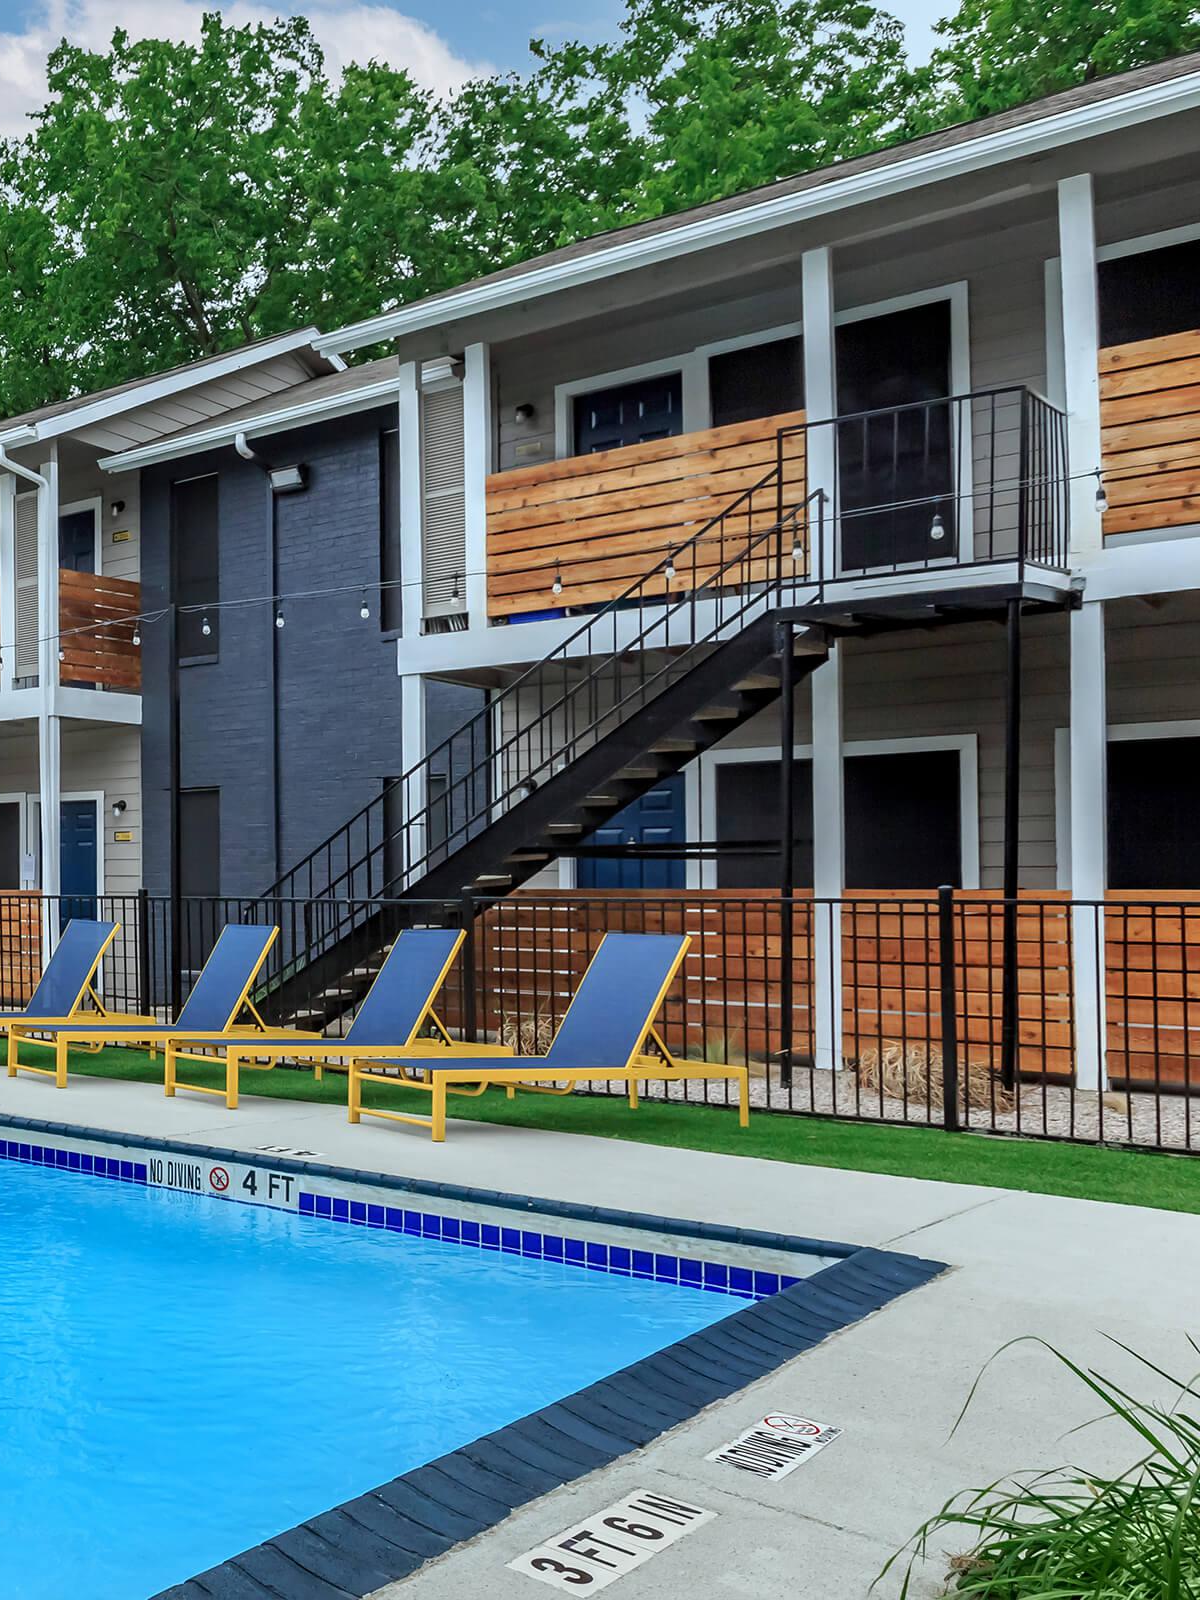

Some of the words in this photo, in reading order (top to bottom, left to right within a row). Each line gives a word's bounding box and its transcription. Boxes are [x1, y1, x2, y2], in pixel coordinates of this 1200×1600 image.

[150, 1158, 163, 1184] NO
[167, 1161, 201, 1190] DIVING
[242, 1170, 257, 1196] 4
[268, 1173, 295, 1202] FT
[726, 1430, 813, 1468] DIVING
[714, 1453, 778, 1479] NO
[628, 1493, 703, 1526] IN
[602, 1516, 665, 1540] 6
[558, 1529, 637, 1568] FT
[531, 1557, 594, 1585] 3
